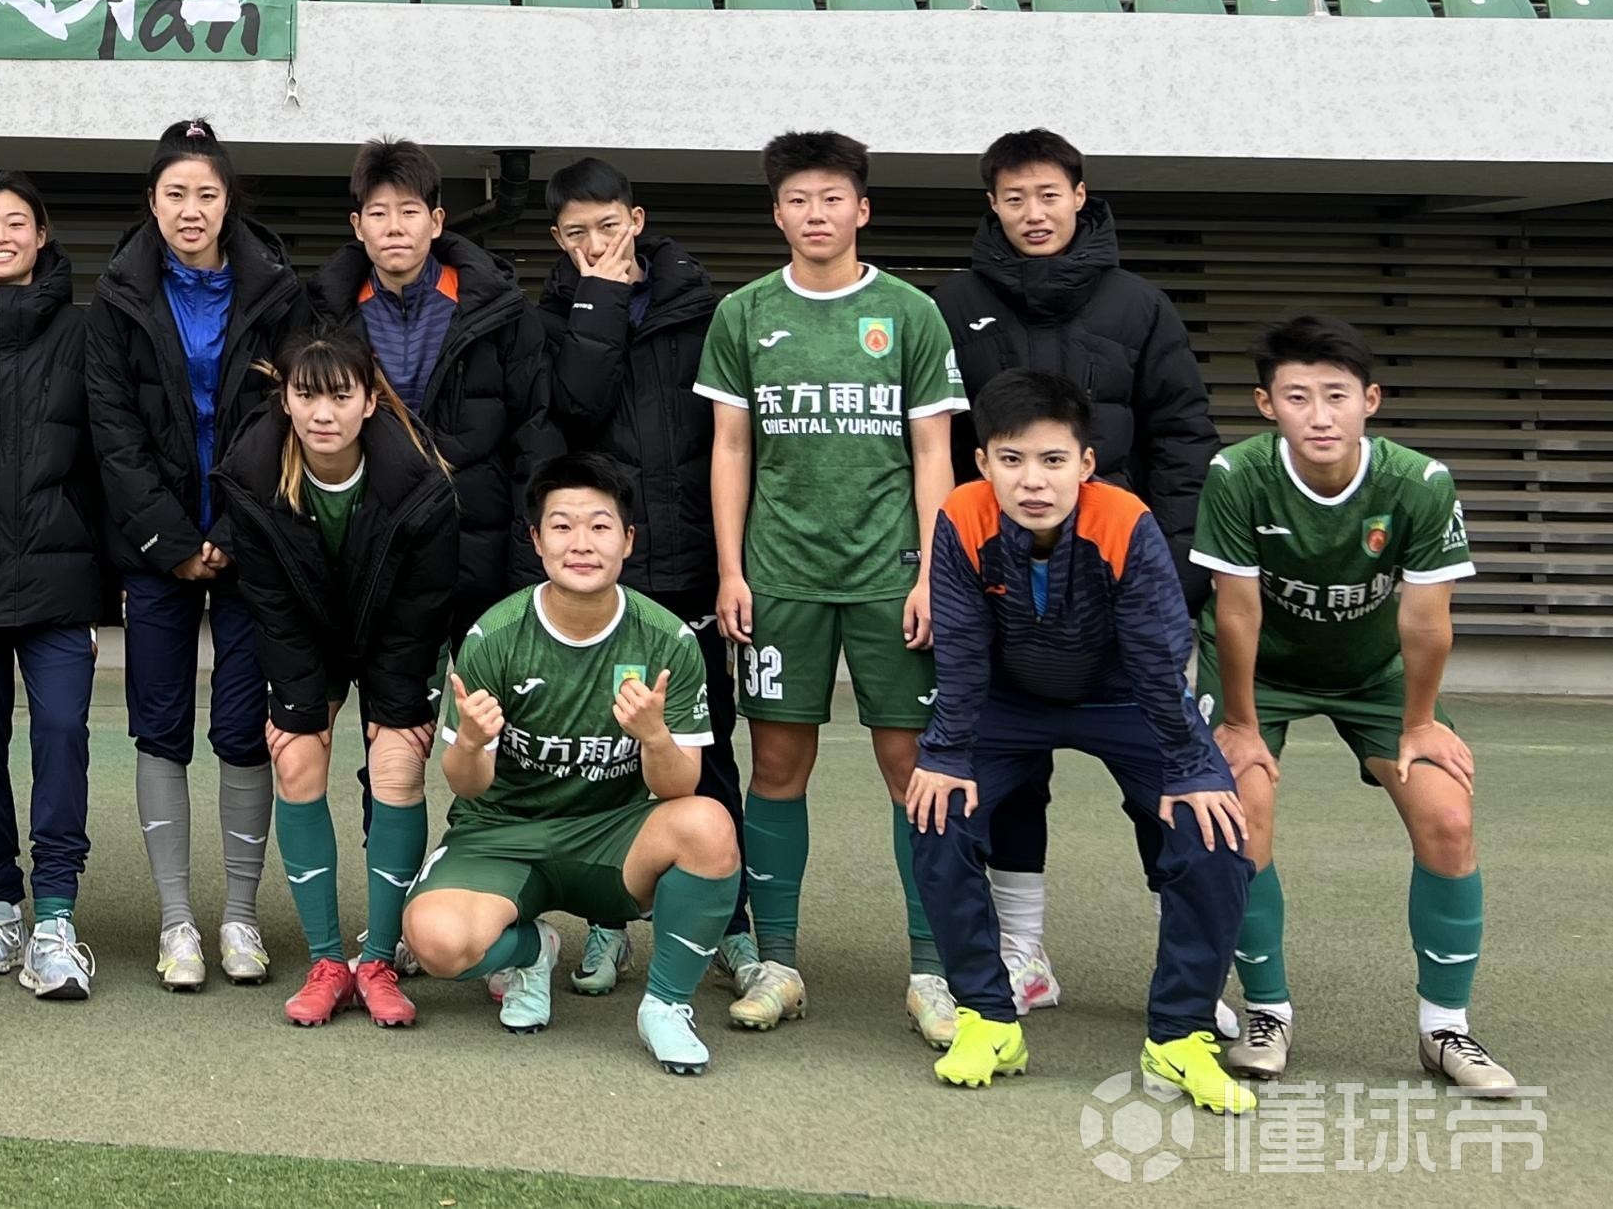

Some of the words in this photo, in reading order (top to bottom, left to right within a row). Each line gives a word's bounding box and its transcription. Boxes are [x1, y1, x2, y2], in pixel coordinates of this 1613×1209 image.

[753, 382, 902, 416] 东方雨虹
[761, 418, 832, 435] ORIENTAL
[835, 418, 903, 437] YUHONG
[744, 645, 783, 700] 32
[503, 722, 641, 764] 东方雨虹
[579, 758, 638, 782] YUHONG
